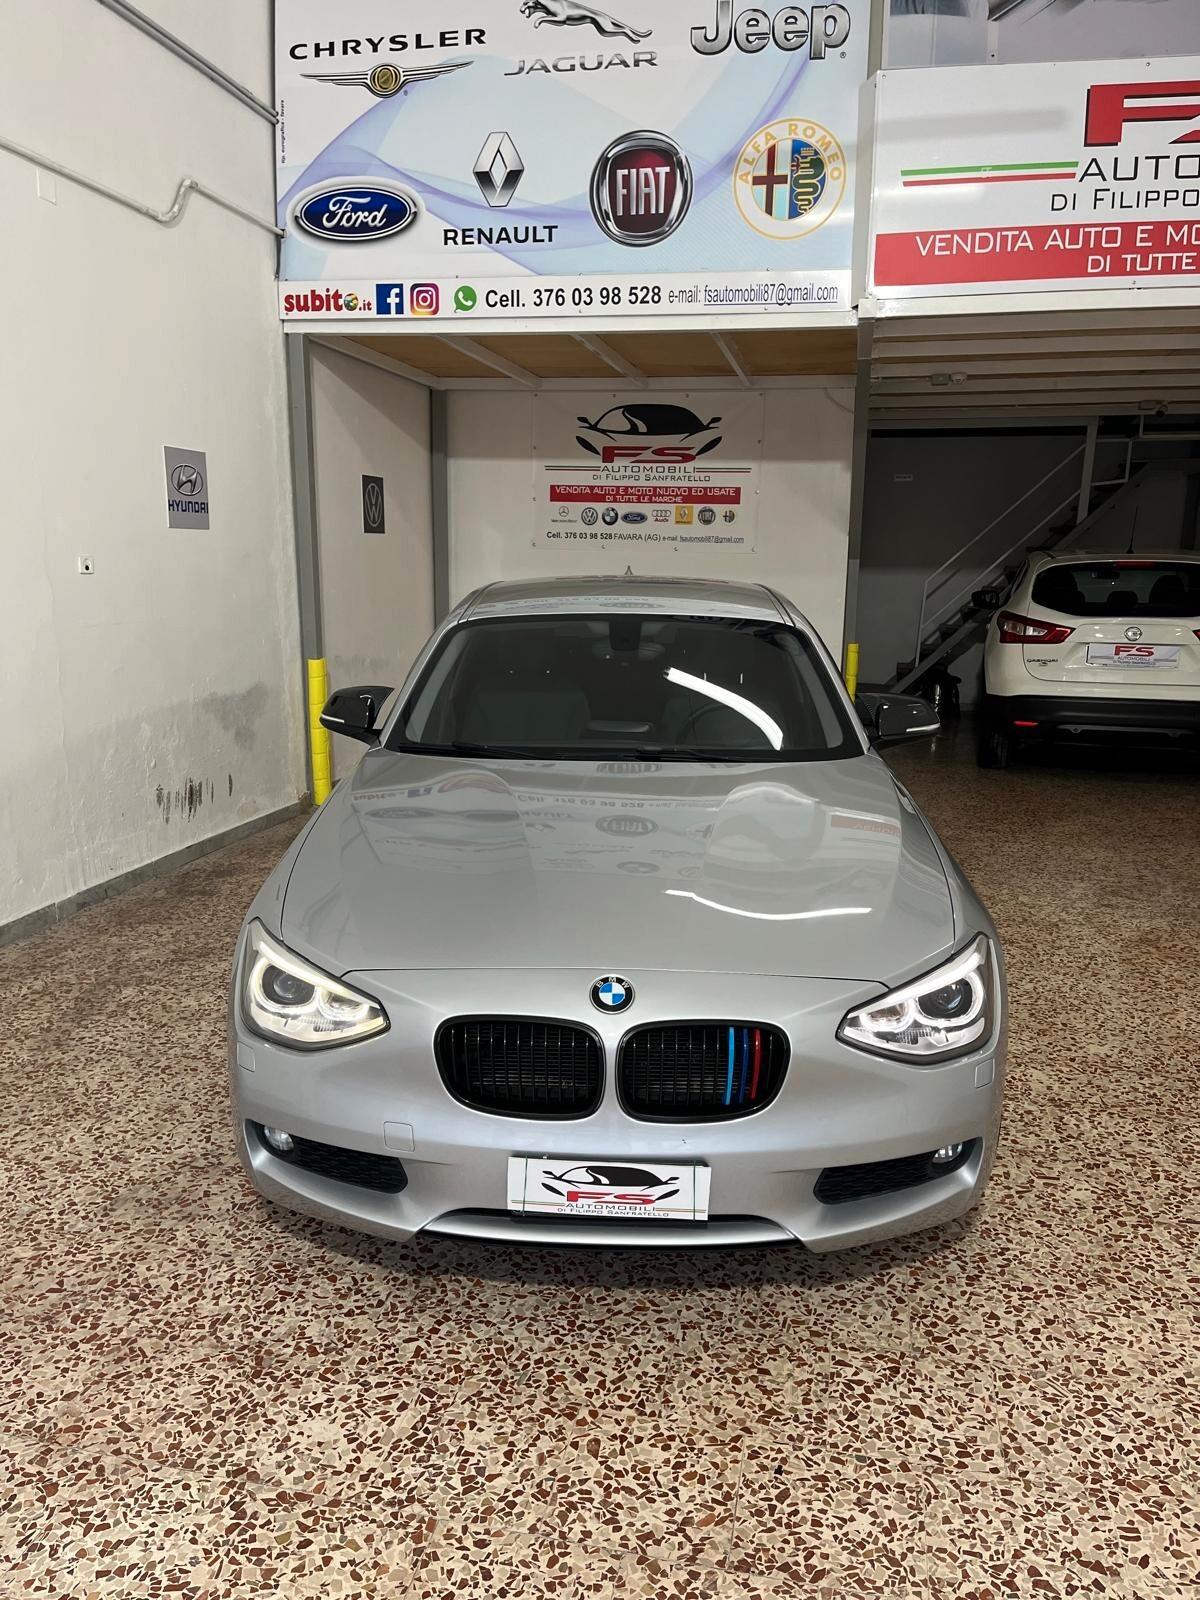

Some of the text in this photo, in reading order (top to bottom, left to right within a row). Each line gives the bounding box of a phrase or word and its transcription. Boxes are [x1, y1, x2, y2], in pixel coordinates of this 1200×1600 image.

[690, 0, 851, 60] Jeep
[289, 28, 486, 60] CHRYSLER
[503, 51, 658, 76] JAGUAR
[738, 123, 841, 184] ALFA ROMEO
[616, 166, 671, 216] FIAT
[1051, 188, 1200, 211] DI FILIPPO
[321, 196, 388, 229] Ford
[443, 225, 559, 246] RENAULT
[915, 230, 1034, 256] VENDITA
[1044, 227, 1122, 250] AUTO
[1136, 225, 1154, 246] E
[1087, 252, 1197, 273] DI TUTTE
[485, 283, 838, 309] Cell. 376 03 98 528 e-mail: fsautomobili87@gmail.com
[602, 446, 697, 464] FS
[601, 465, 696, 474] AUTOMOBILI
[605, 473, 641, 481] FILIPPO
[644, 473, 711, 482] SANFRATELLO
[555, 486, 736, 496] VENDITA AUTO E MOTO NUOVO ED USATE
[168, 499, 209, 514] HYUNDAI
[546, 531, 563, 539] Cell.
[589, 532, 598, 540] 98
[644, 533, 661, 543] (AG)
[1113, 645, 1155, 657] FS
[566, 1191, 656, 1205] FS
[566, 1203, 656, 1212] AUTOMOBILI
[571, 1207, 603, 1215] FILIPPO
[607, 1209, 669, 1218] SANFRATELLO
